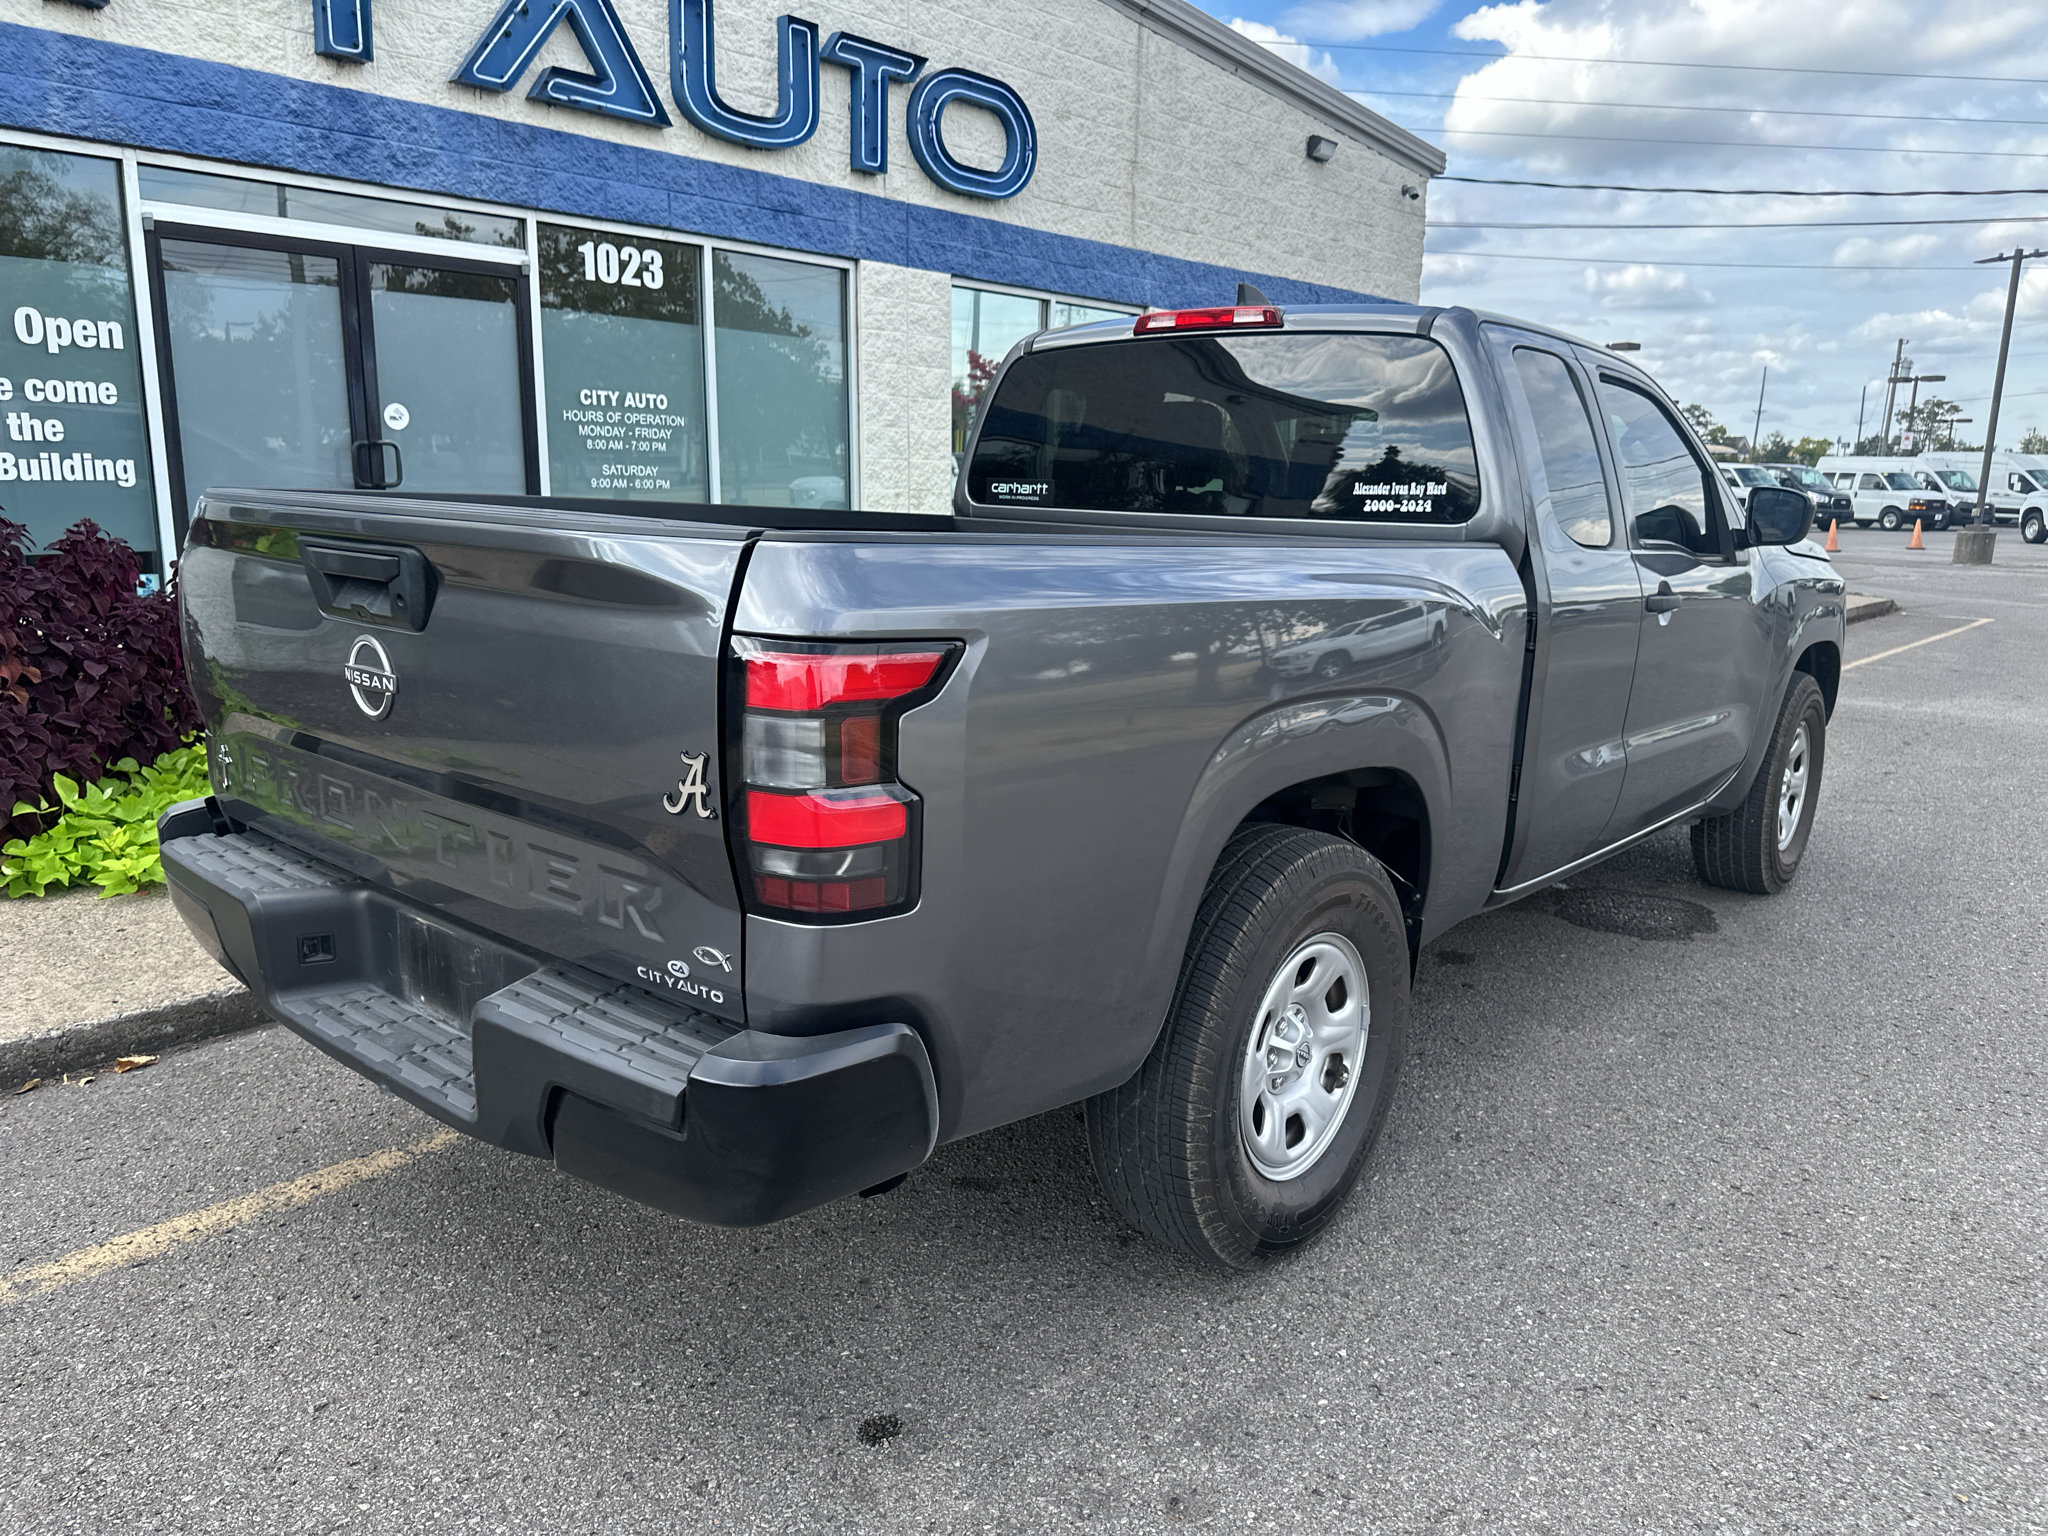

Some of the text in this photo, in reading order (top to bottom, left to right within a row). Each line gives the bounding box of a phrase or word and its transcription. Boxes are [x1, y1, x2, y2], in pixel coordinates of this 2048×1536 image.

[448, 0, 1038, 200] AUTO
[577, 241, 664, 290] 1023
[14, 306, 125, 354] Open
[24, 377, 118, 405] come
[580, 389, 668, 409] CITY AUTO
[6, 412, 65, 442] the
[563, 410, 685, 427] HOURS OF OPERATION
[578, 425, 626, 437] MONDAY
[635, 427, 672, 439] FRIDAY
[586, 439, 606, 450] 8:00
[608, 440, 623, 450] AM
[631, 441, 650, 451] 7:00
[652, 442, 667, 452] PM
[0, 453, 137, 488] Building
[602, 464, 658, 477] SATURDAY
[590, 478, 611, 488] 9:00
[612, 478, 627, 488] AM
[635, 479, 654, 489] 6:00
[656, 480, 670, 489] PM
[991, 482, 1048, 495] carhartt
[1353, 482, 1391, 495] Alexander
[1391, 482, 1409, 495] Ivan
[1410, 482, 1426, 498] Ray
[1363, 499, 1432, 512] 2000-2024
[344, 666, 394, 691] NISSAN
[662, 750, 714, 818] A
[238, 742, 665, 943] FRONTIER
